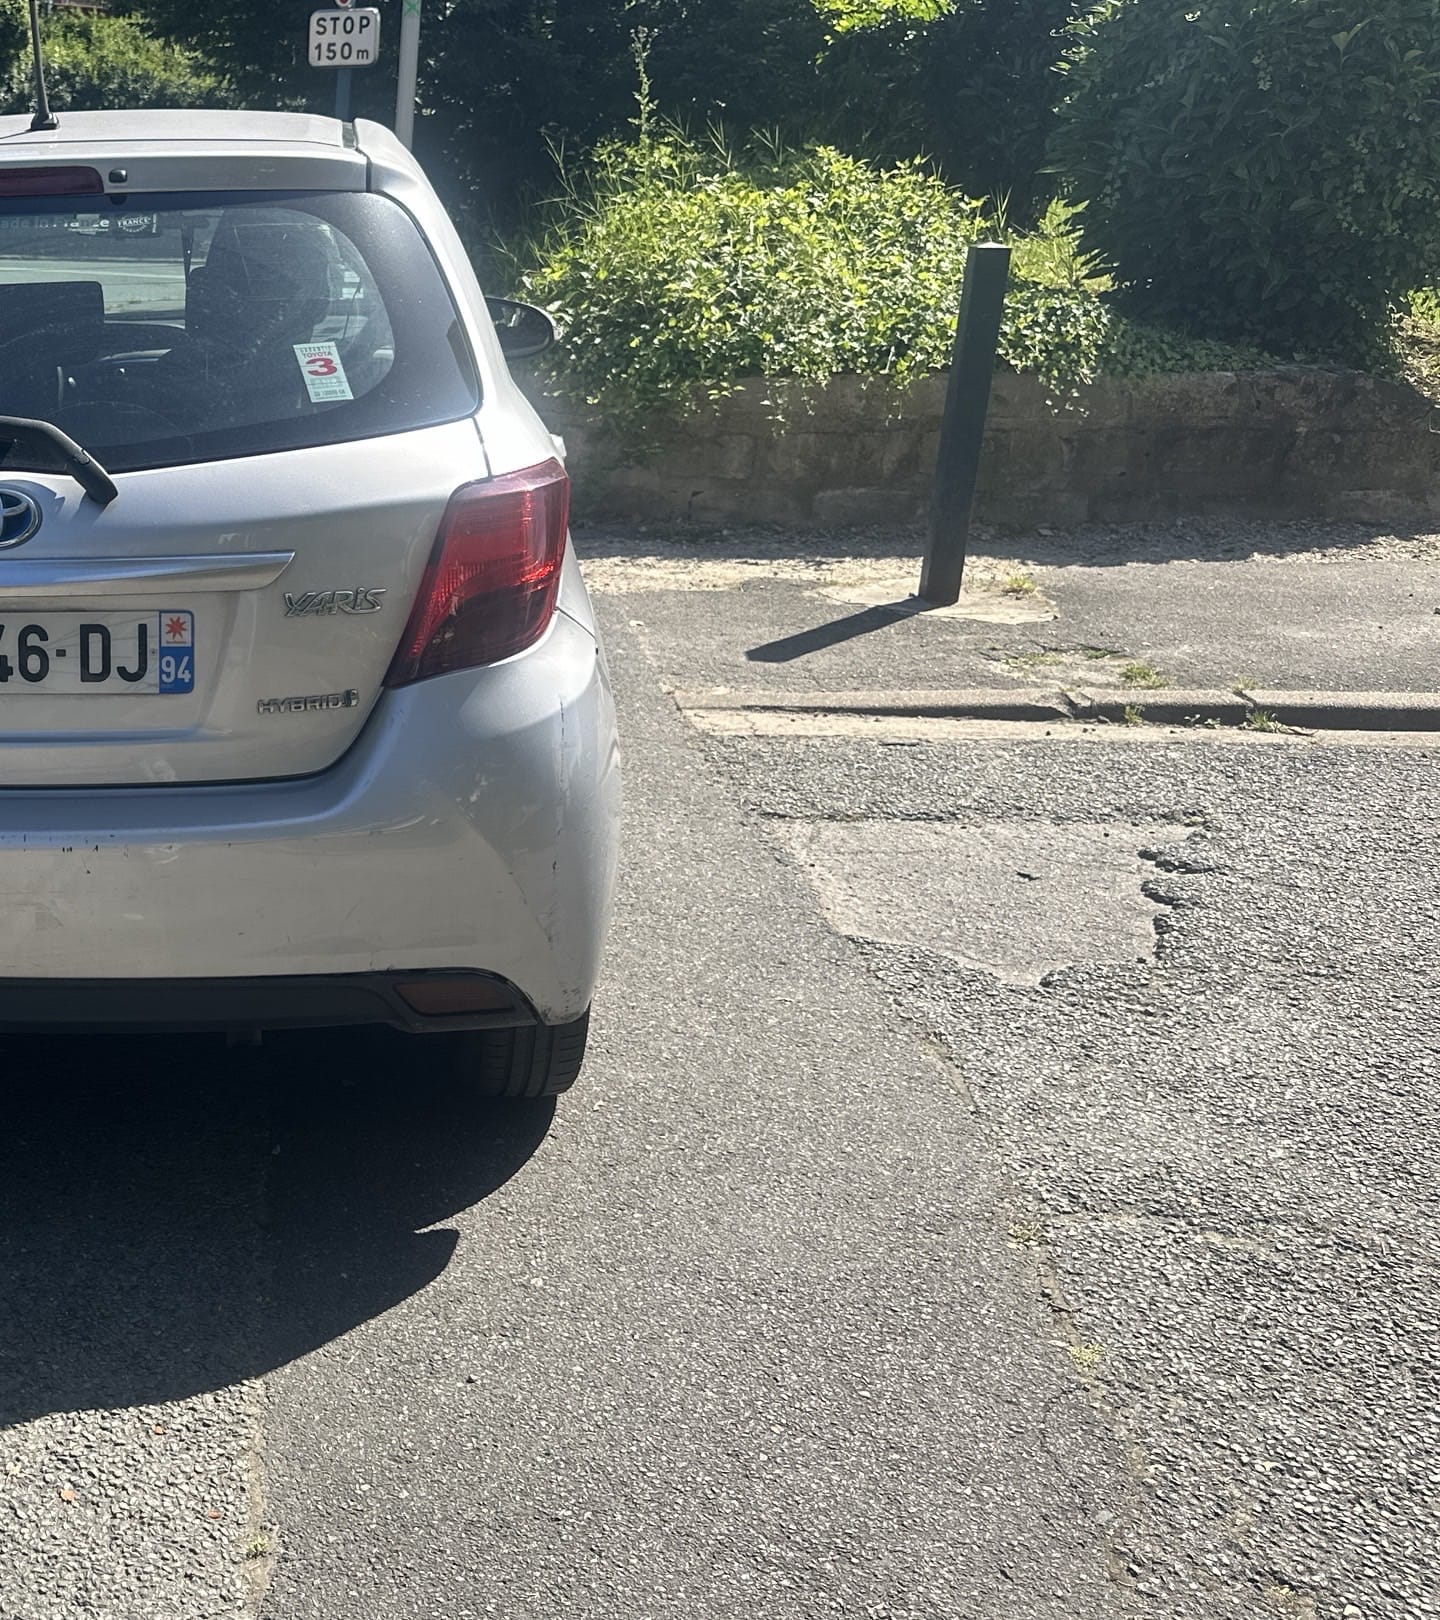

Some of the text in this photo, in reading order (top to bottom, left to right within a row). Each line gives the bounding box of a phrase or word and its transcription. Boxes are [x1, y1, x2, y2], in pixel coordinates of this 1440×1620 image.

[315, 15, 371, 36] STOP
[303, 351, 333, 359] TOYOTA
[305, 357, 337, 376] 3
[161, 656, 192, 683] 94
[257, 693, 342, 715] HYBRID
